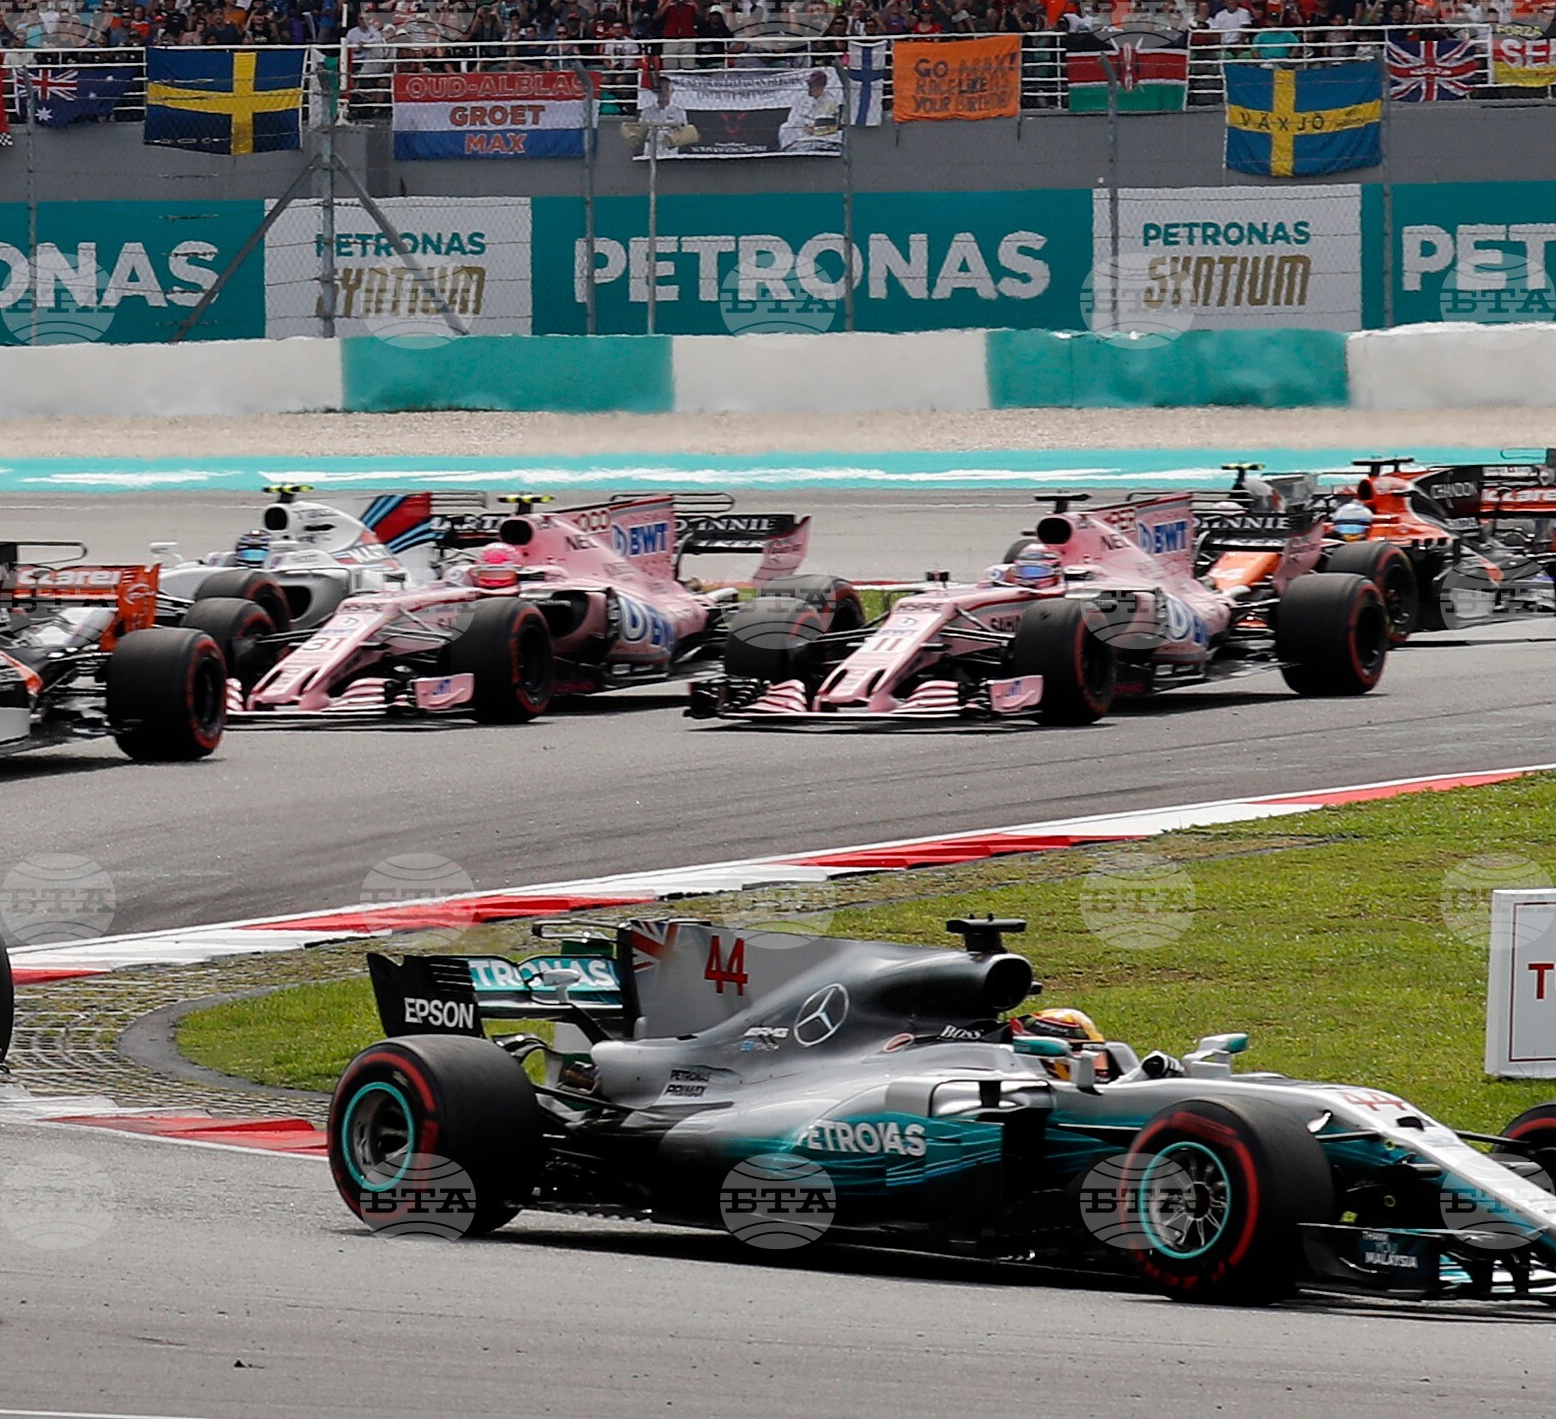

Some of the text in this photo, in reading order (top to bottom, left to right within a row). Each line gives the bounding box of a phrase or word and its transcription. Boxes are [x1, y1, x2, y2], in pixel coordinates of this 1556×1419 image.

[1496, 23, 1542, 37] FORZA
[913, 58, 949, 78] GO
[449, 105, 546, 126] GROET
[1239, 111, 1325, 132] VÄXJÖ
[465, 133, 528, 155] MAX
[1142, 221, 1311, 247] PETRONAS
[574, 230, 1051, 305] PETRONAS
[1144, 254, 1312, 307] SYNTIUM
[628, 523, 669, 556] BWT
[1152, 520, 1188, 554] BWT
[704, 934, 749, 996] 44
[404, 997, 475, 1029] EPSON
[941, 1024, 983, 1040] BOSS
[1343, 1090, 1407, 1112] 44
